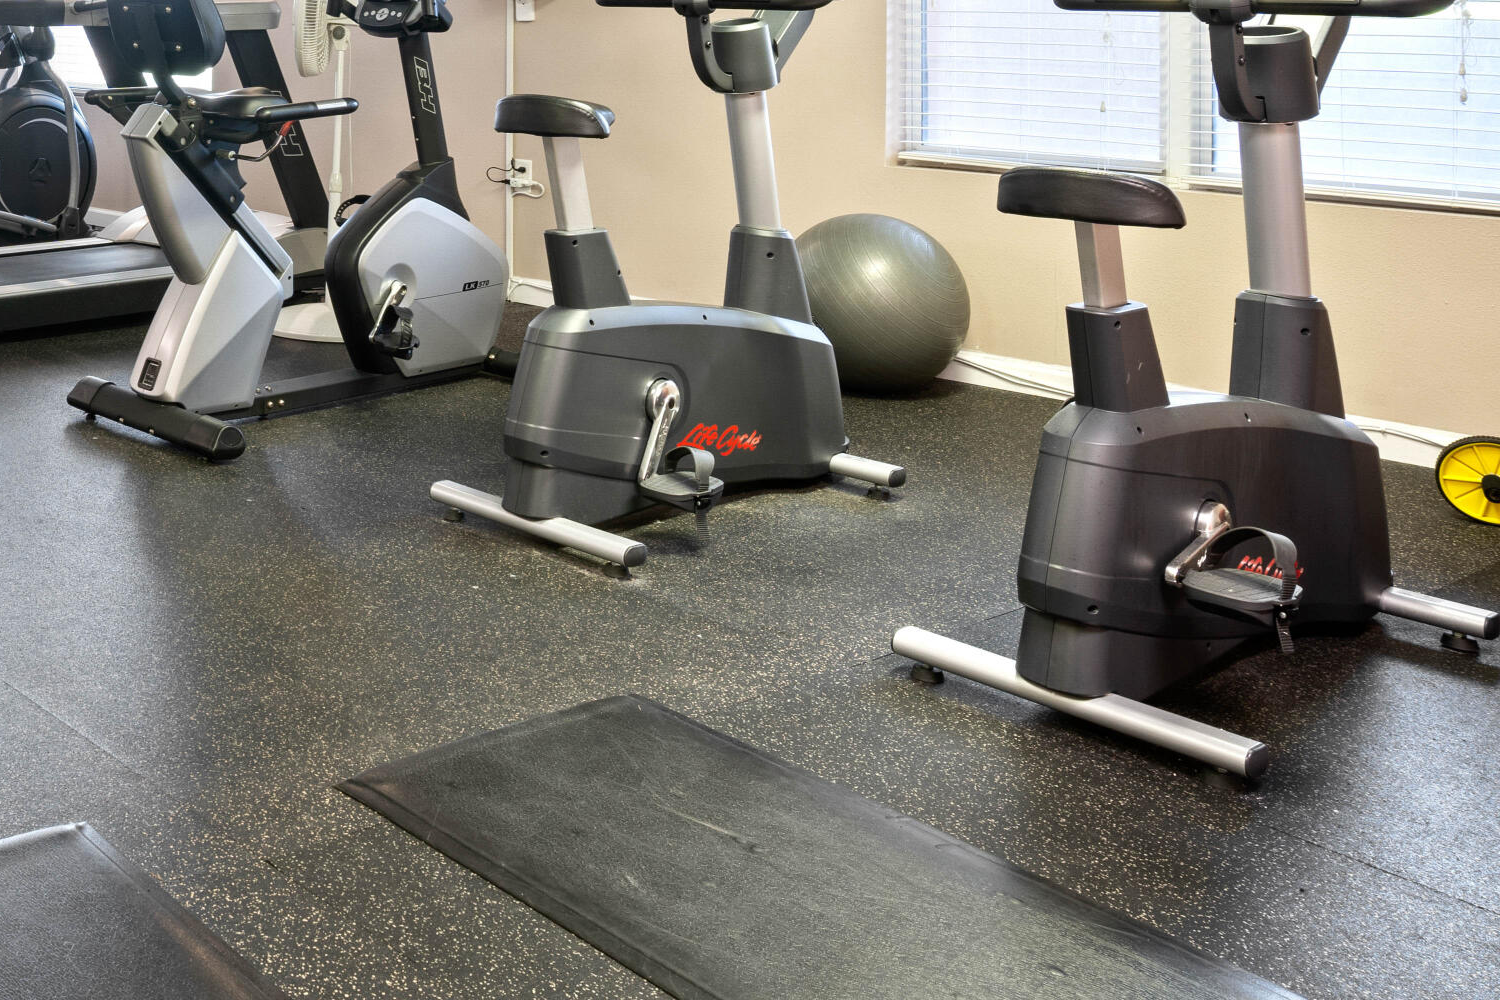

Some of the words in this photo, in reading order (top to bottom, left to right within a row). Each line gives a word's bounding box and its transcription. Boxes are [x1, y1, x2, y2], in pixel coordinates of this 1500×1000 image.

[413, 56, 437, 115] BH
[676, 423, 718, 451] Life
[716, 424, 763, 457] Cycle
